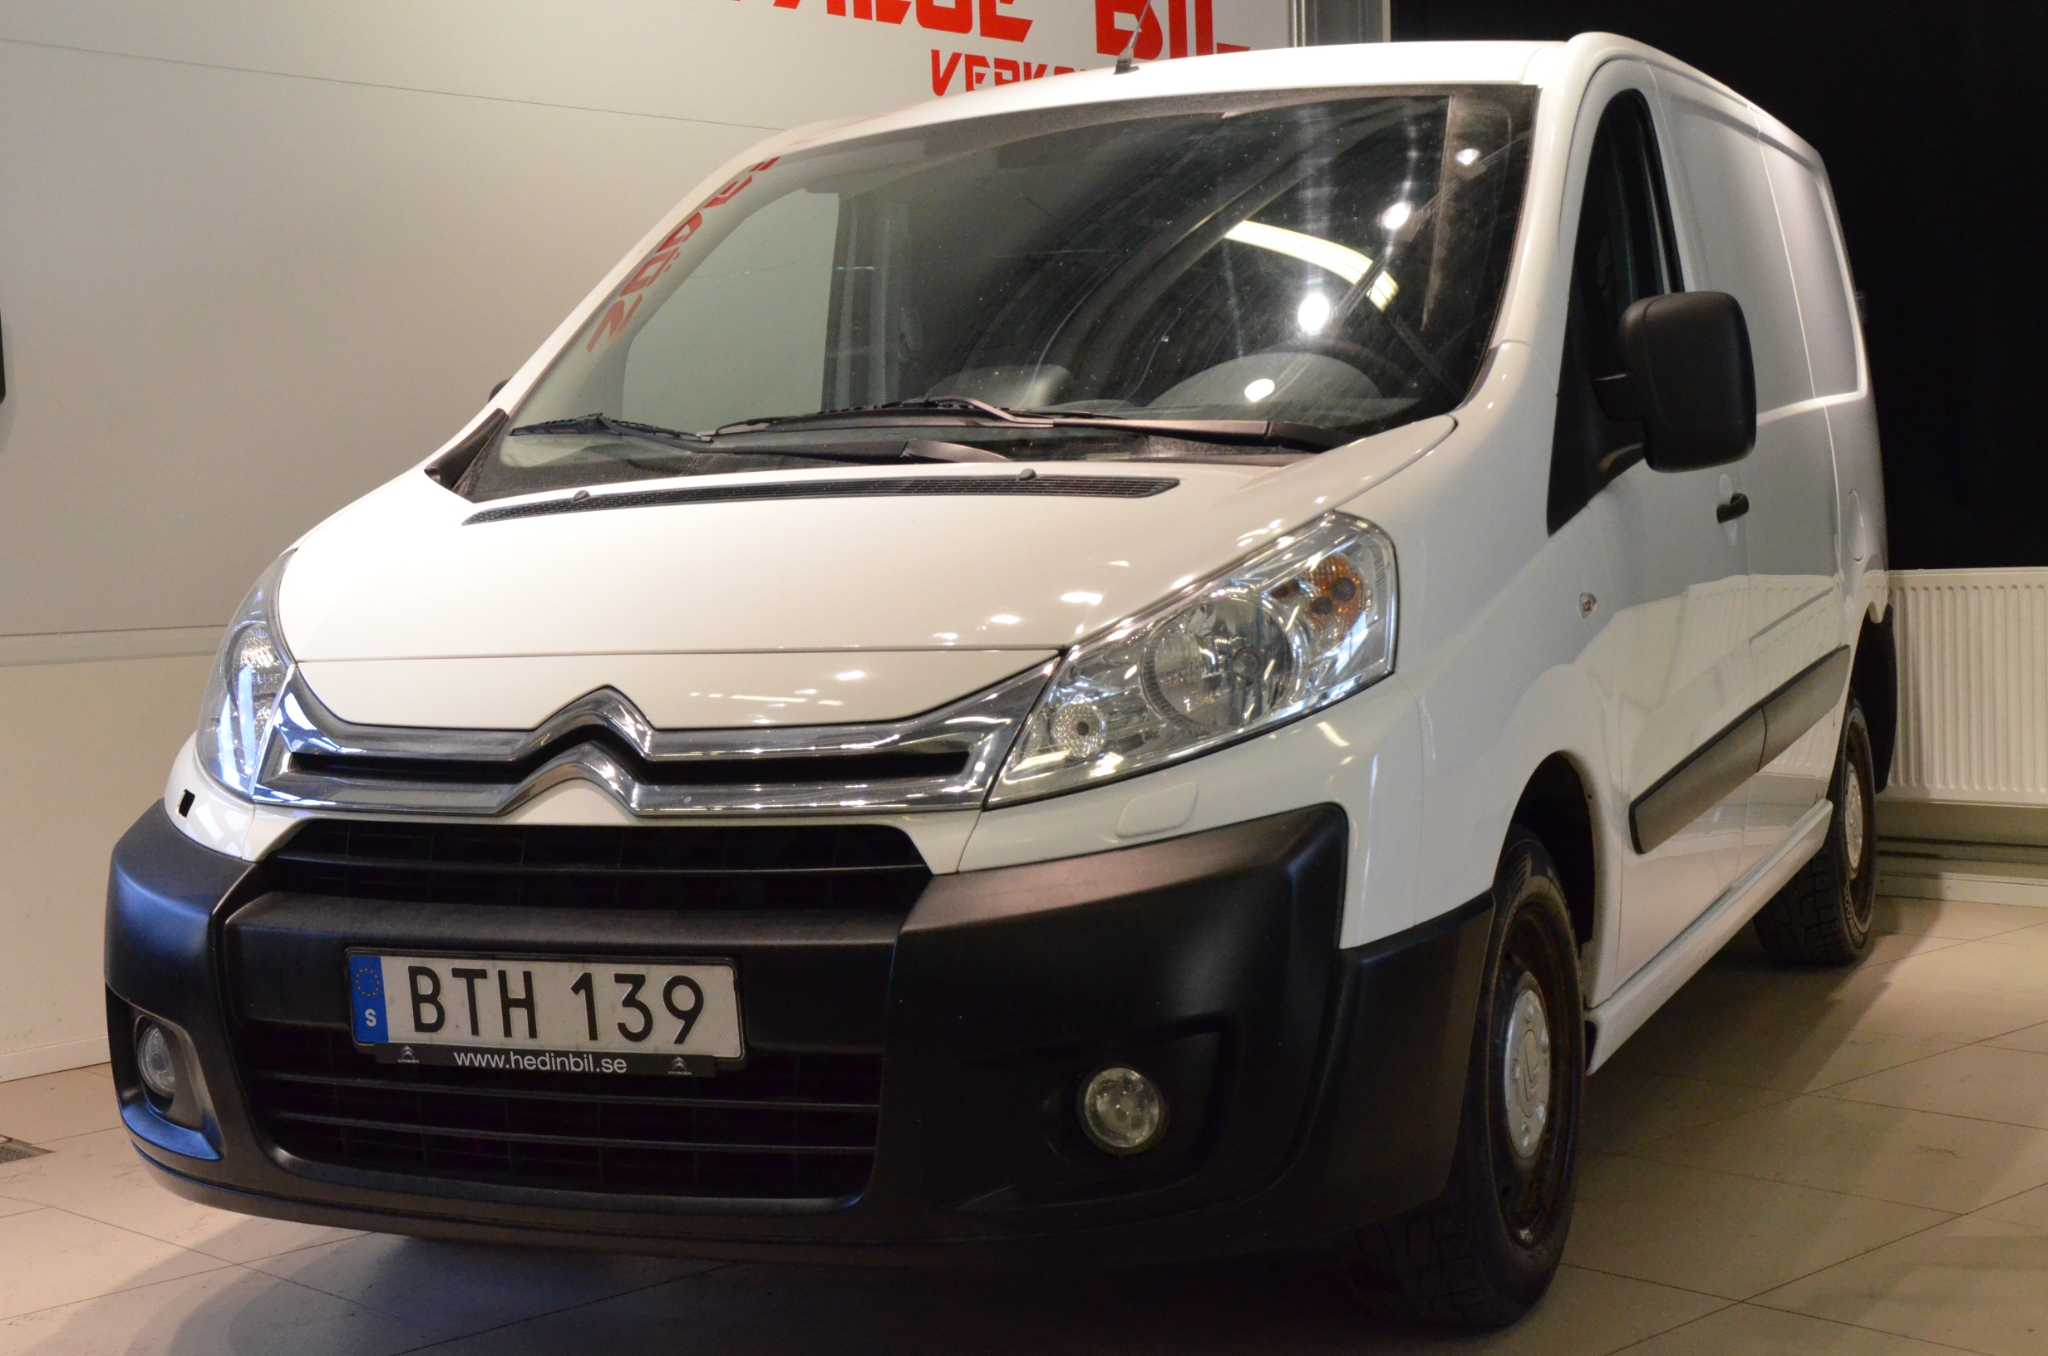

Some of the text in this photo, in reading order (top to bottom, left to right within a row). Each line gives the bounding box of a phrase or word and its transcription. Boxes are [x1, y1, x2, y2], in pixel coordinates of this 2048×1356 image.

[408, 965, 705, 1046] BTH 139
[365, 1008, 377, 1028] S
[453, 1051, 627, 1073] www.hedinbil.se
